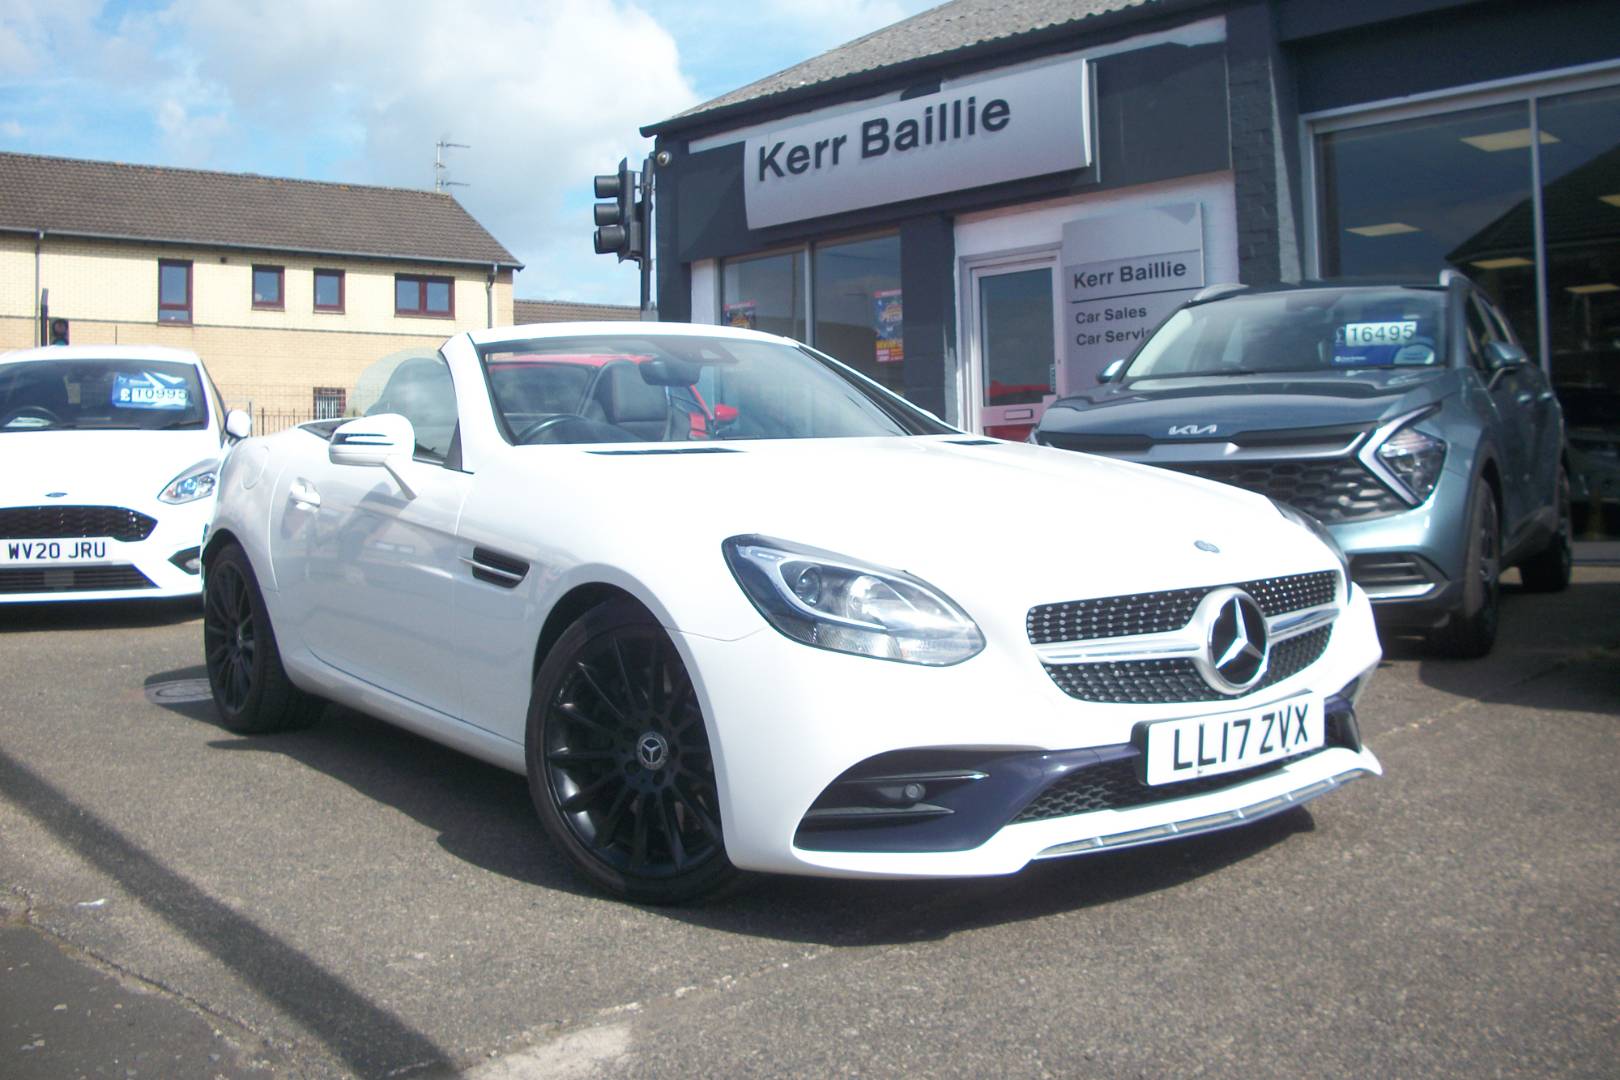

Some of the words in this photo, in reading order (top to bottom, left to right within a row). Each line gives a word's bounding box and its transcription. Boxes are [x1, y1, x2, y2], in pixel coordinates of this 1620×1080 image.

[758, 134, 847, 181] Kerr
[861, 97, 1010, 159] Baillie
[1073, 272, 1114, 289] Kerr
[1120, 262, 1186, 282] Baillie
[1075, 312, 1101, 325] Car
[1104, 306, 1148, 321] Sales
[1076, 334, 1101, 346] Car
[8, 542, 61, 560] WV20
[68, 542, 106, 559] JRU
[1173, 718, 1251, 770] LL17
[1259, 704, 1307, 754] ZVX
